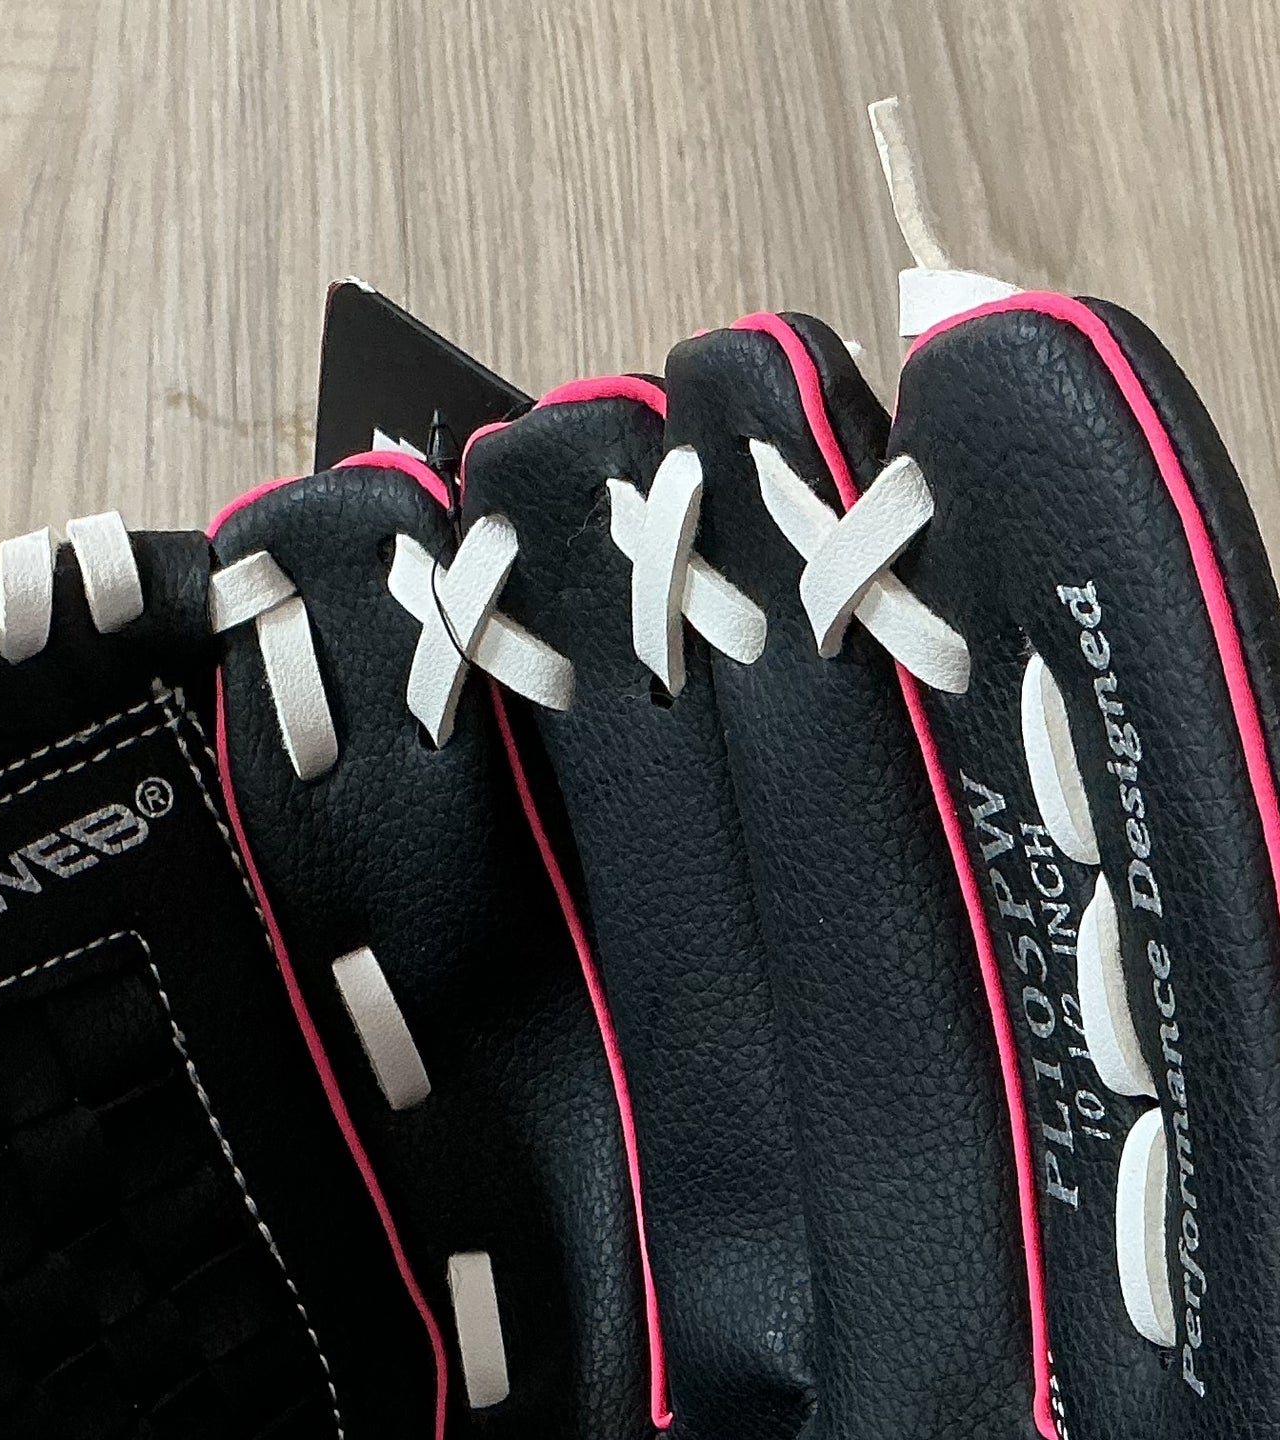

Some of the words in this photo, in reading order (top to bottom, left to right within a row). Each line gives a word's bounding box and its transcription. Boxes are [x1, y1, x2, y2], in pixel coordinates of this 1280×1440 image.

[1020, 822, 1078, 956] INCH
[1057, 580, 1162, 917] Designed
[959, 767, 1079, 1211] PL105PW
[1075, 1089, 1111, 1140] 10
[1147, 939, 1207, 1397] Performance
